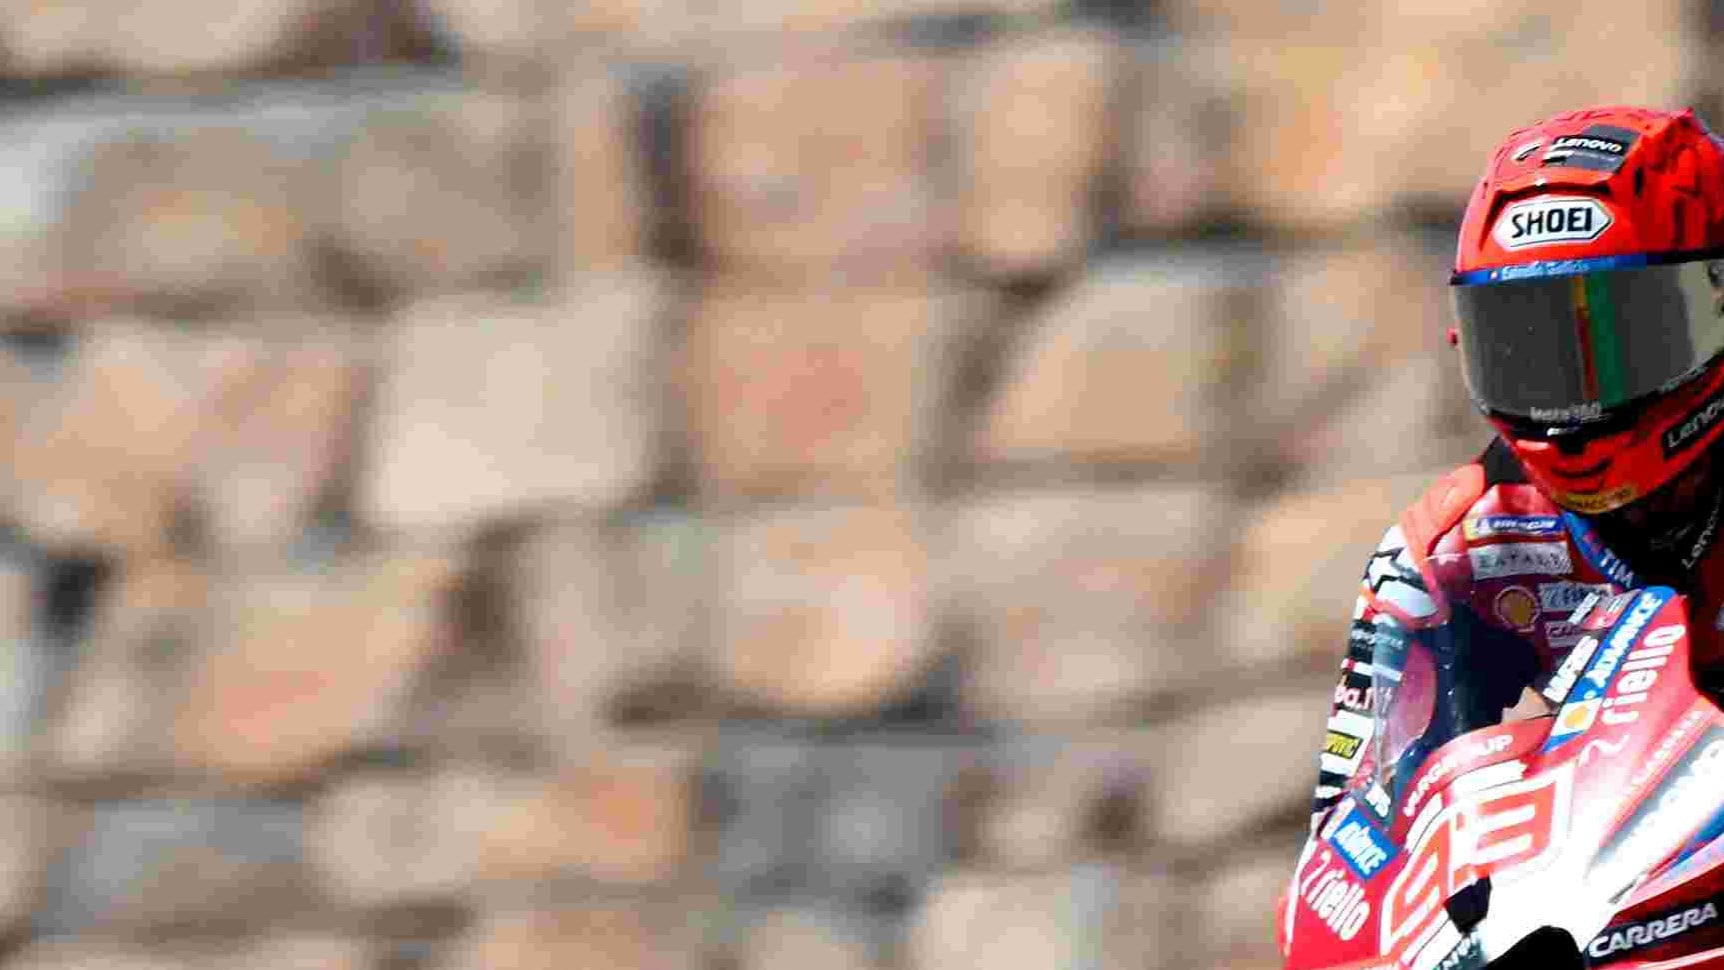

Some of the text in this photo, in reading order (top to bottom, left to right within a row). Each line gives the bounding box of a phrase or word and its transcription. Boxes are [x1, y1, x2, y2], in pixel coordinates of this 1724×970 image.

[1510, 206, 1594, 239] SHOEI
[1601, 624, 1686, 724] riello
[1306, 867, 1371, 942] riello
[1588, 902, 1719, 960] CARRERA
